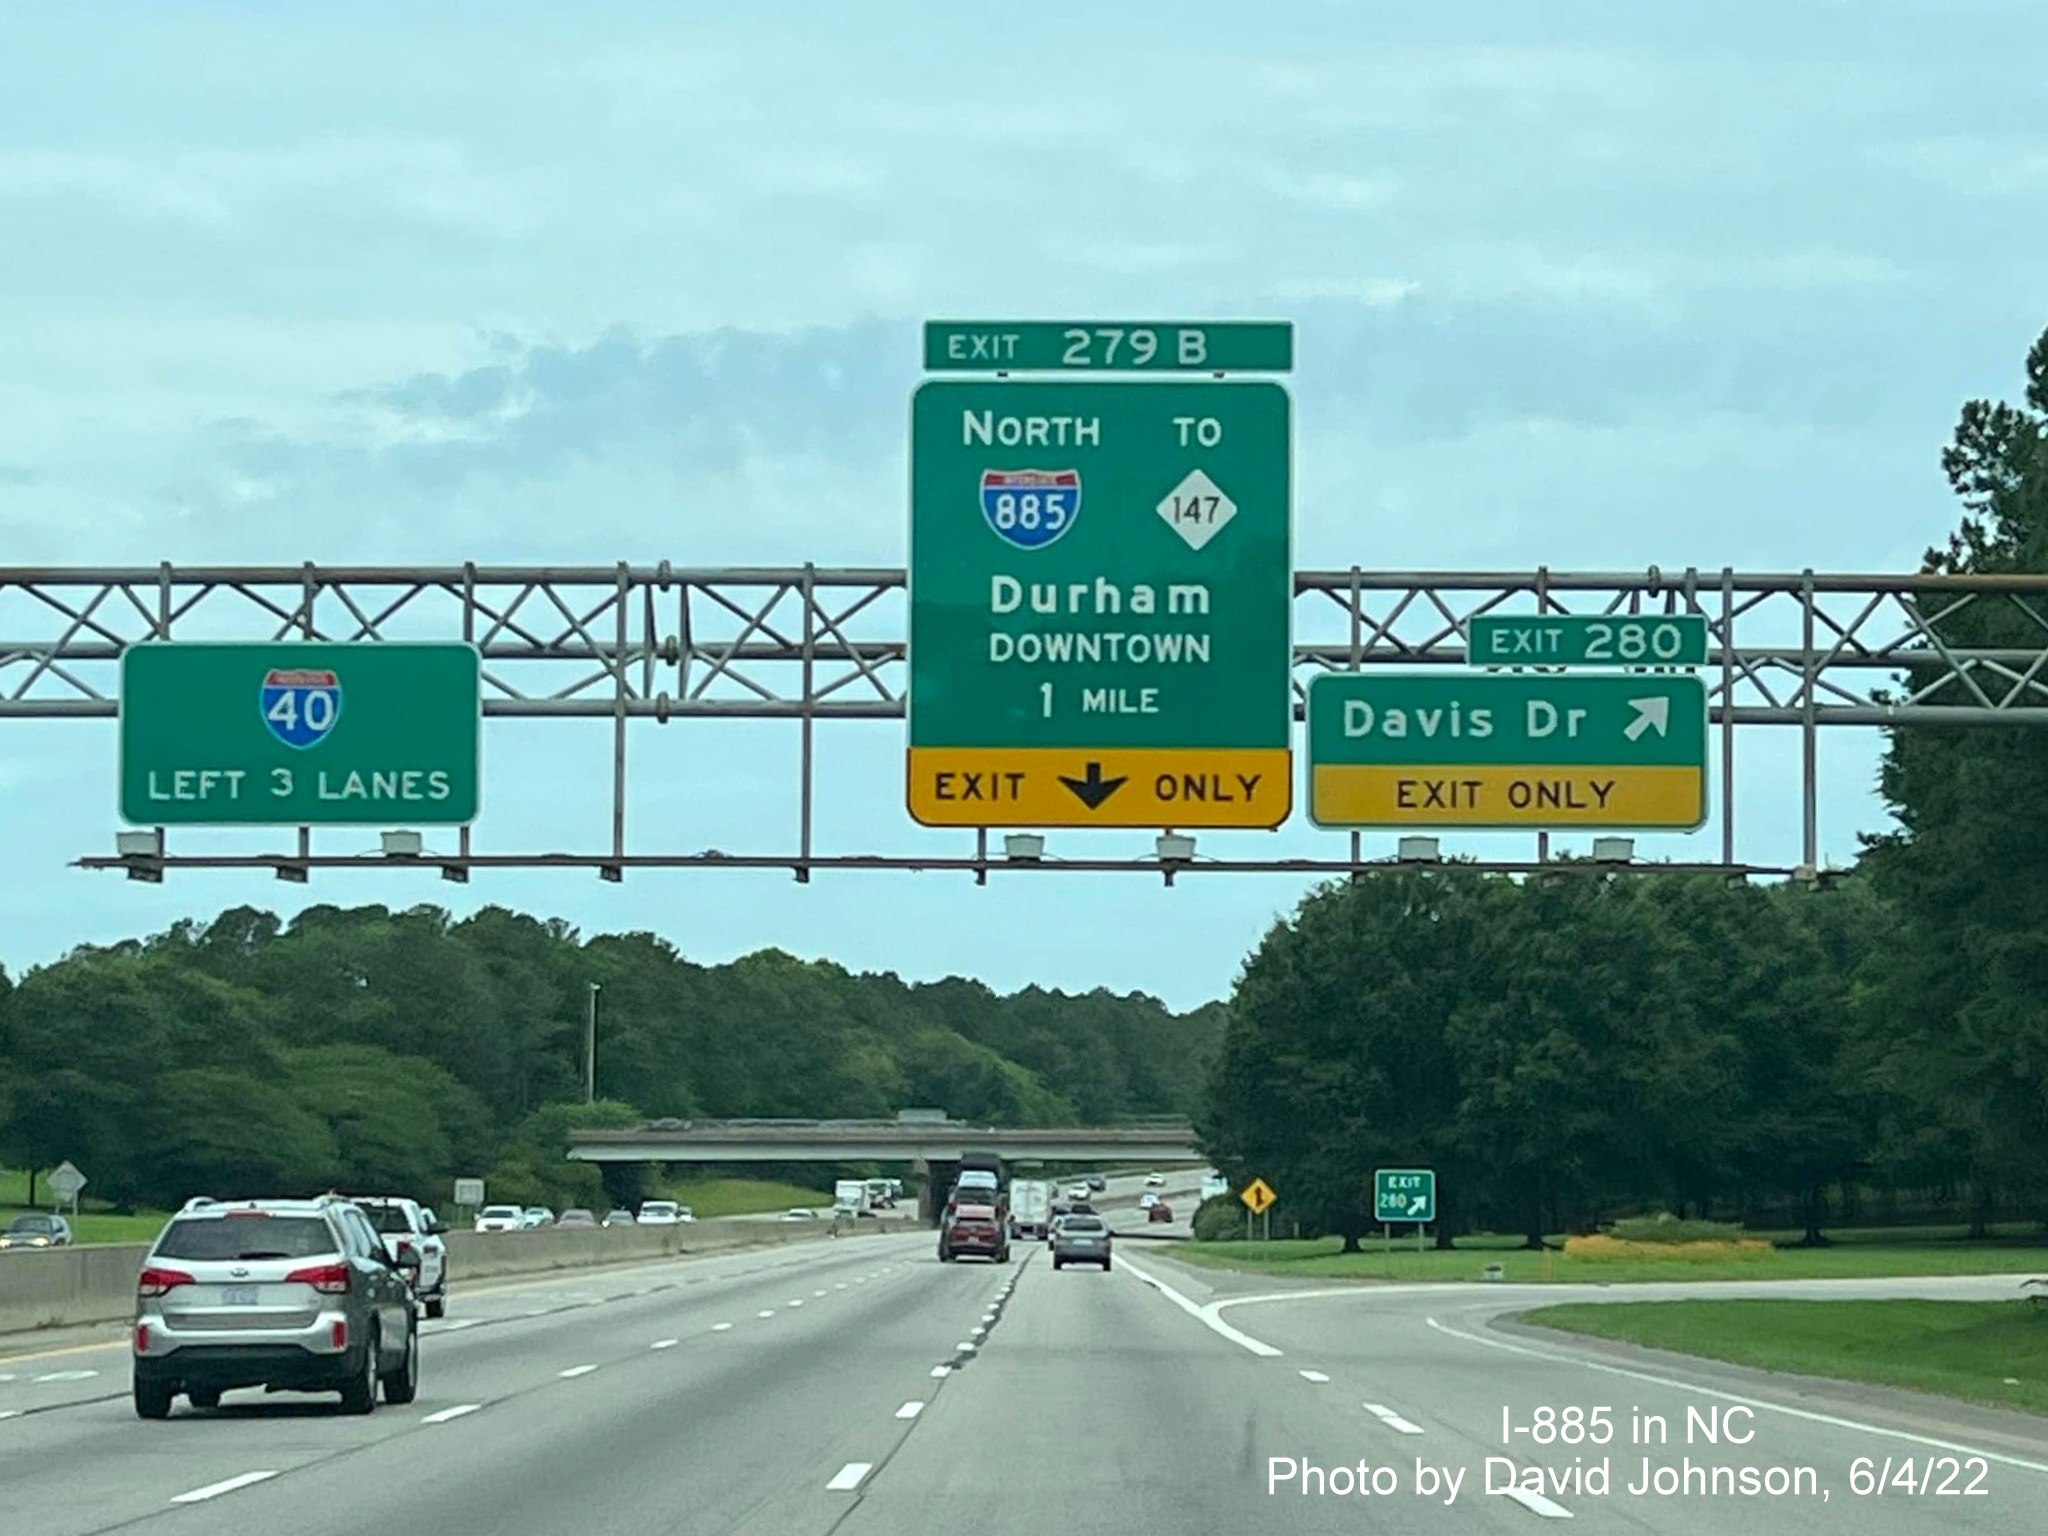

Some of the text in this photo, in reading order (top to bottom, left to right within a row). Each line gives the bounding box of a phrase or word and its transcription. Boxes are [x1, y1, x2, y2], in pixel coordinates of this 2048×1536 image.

[948, 329, 1207, 365] EXIT 279 B
[963, 410, 1222, 446] NORTH TO
[995, 494, 1066, 530] 885
[1172, 496, 1220, 524] 147
[991, 575, 1210, 614] Durham
[990, 634, 1210, 663] DOWNTOWN
[1491, 624, 1682, 659] EXIT 280
[268, 690, 334, 731] 40
[1040, 682, 1160, 718] 1 MILE
[1344, 701, 1587, 738] Davis Dr
[149, 768, 450, 800] LEFT 3 LANES
[935, 773, 1262, 802] EXIT ONLY
[1397, 781, 1616, 808] EXIT ONLY
[1388, 1176, 1421, 1189] EXIT
